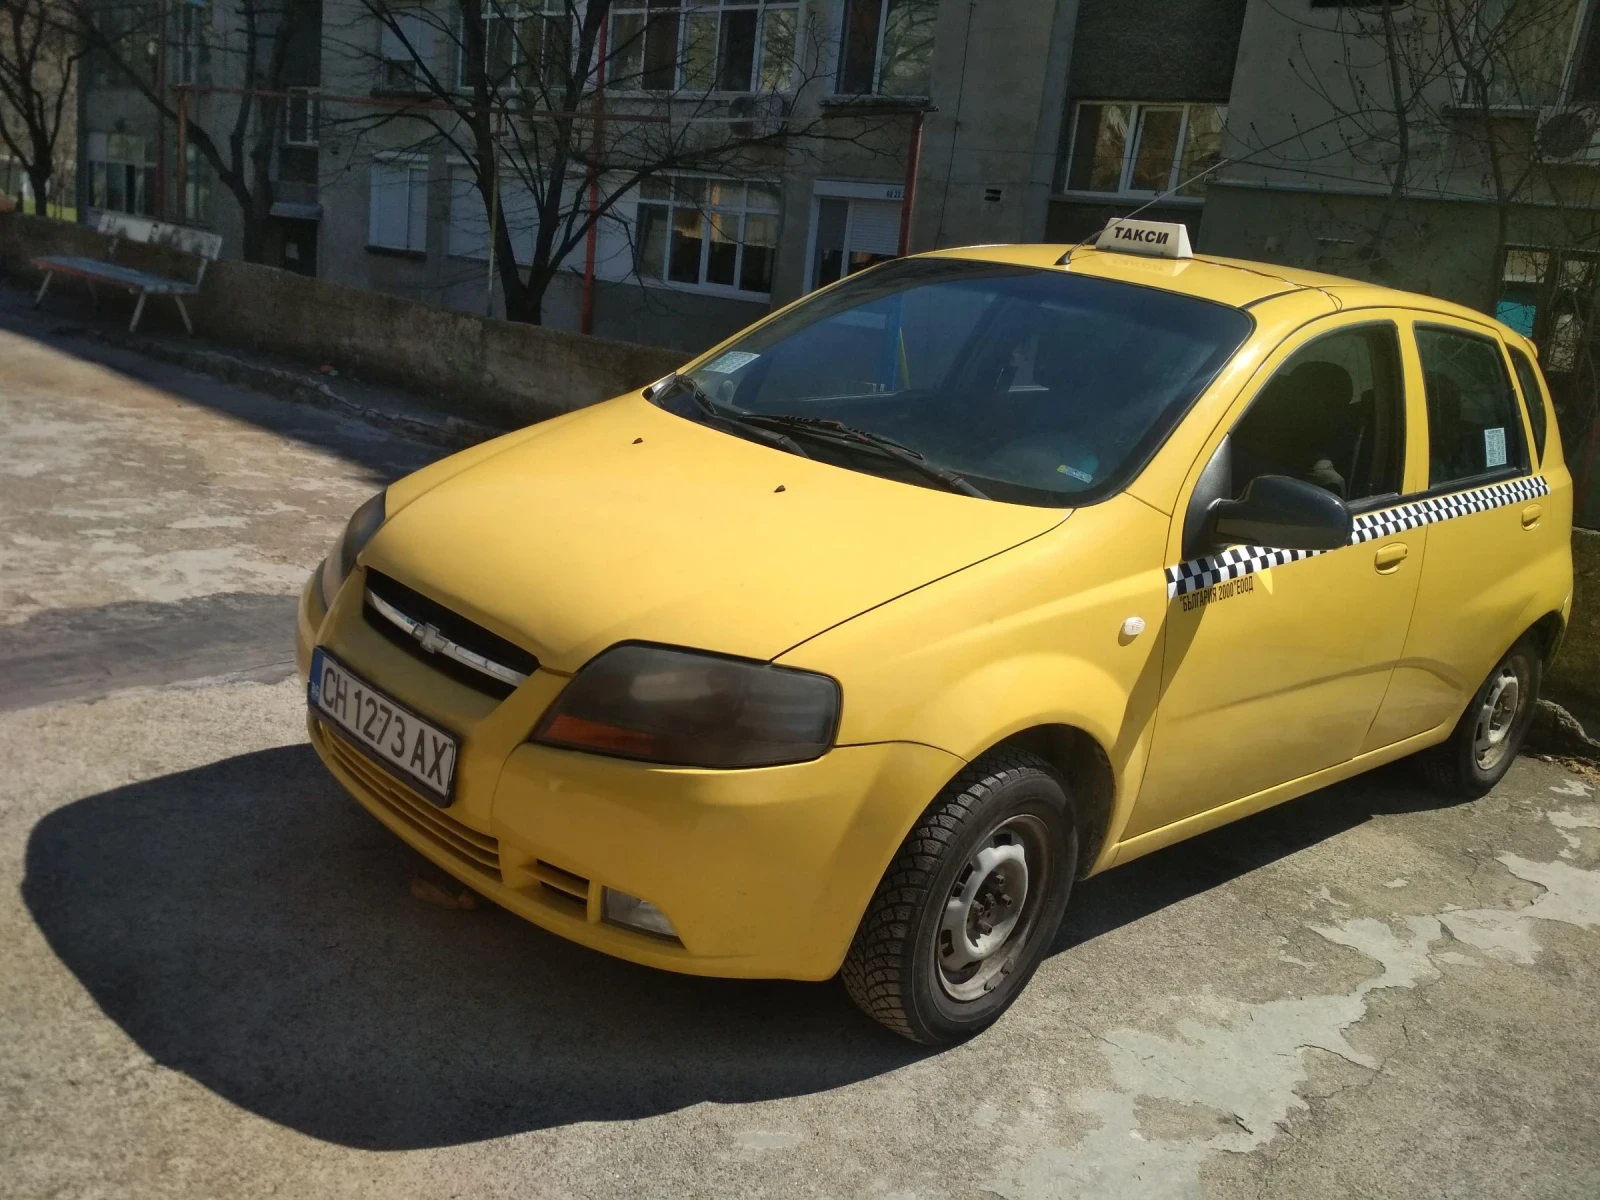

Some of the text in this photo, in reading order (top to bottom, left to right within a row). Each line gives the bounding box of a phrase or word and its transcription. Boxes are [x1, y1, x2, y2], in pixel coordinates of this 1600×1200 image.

[1114, 226, 1170, 245] ТАКСИ
[323, 667, 448, 787] CH 1273 AX
